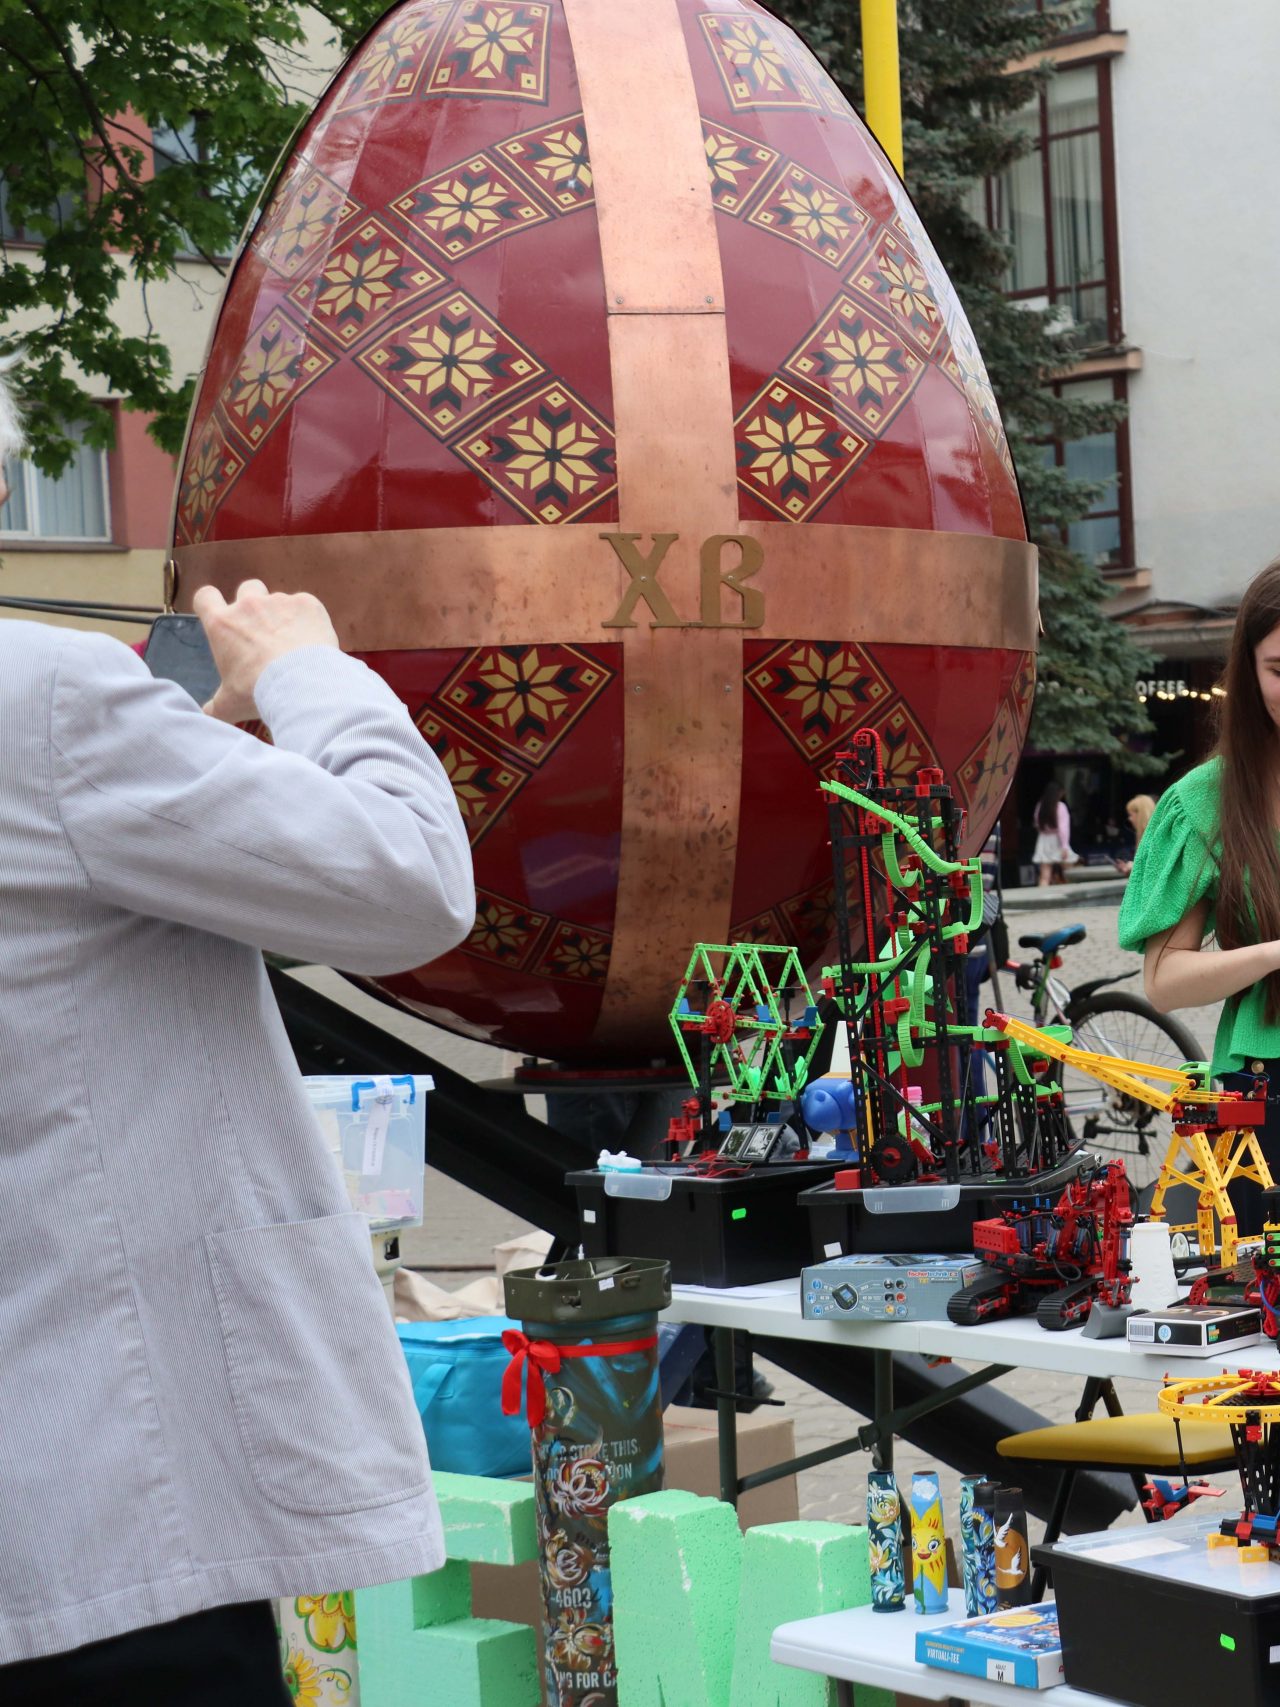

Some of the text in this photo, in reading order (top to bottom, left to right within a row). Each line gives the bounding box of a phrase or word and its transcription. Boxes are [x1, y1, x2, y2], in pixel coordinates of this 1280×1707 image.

[1135, 680, 1186, 697] OFFEE
[611, 1438, 637, 1457] THIS
[576, 1672, 599, 1689] FOR
